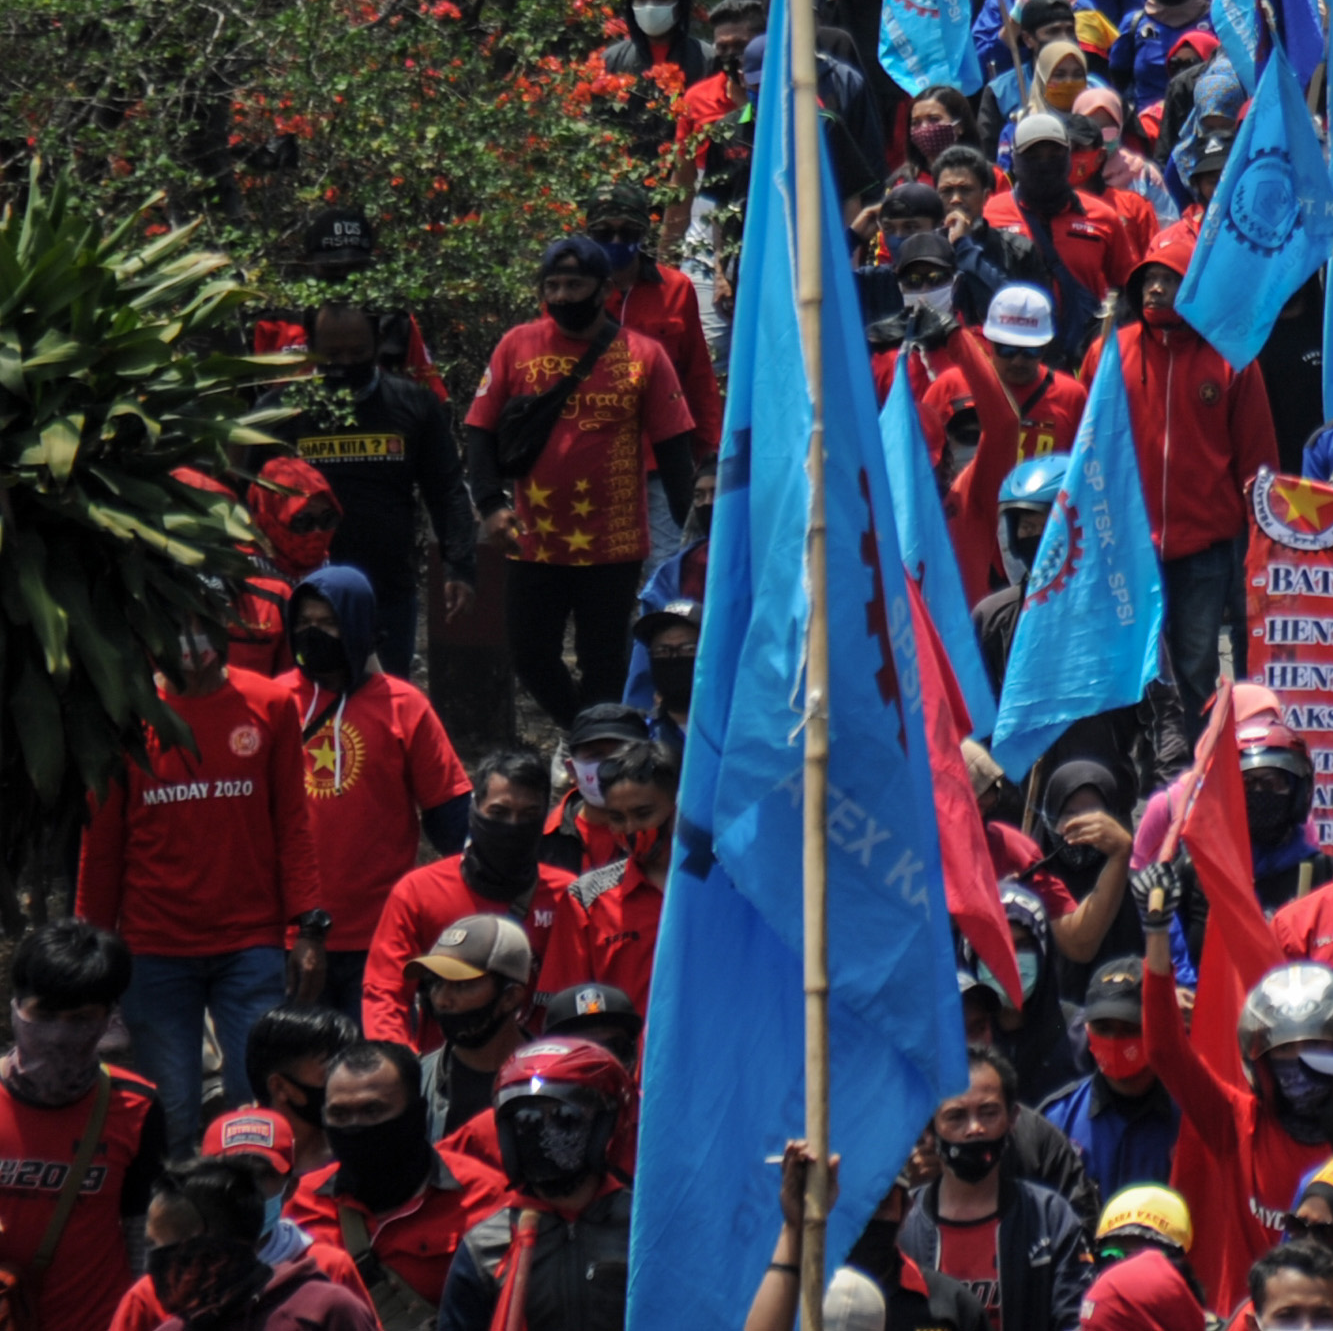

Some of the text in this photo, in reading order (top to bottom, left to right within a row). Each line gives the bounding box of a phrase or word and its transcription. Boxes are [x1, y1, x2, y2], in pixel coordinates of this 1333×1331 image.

[338, 433, 368, 453] KITA
[1107, 574, 1135, 627] SPSI
[142, 779, 252, 807] MAYDAY 2020
